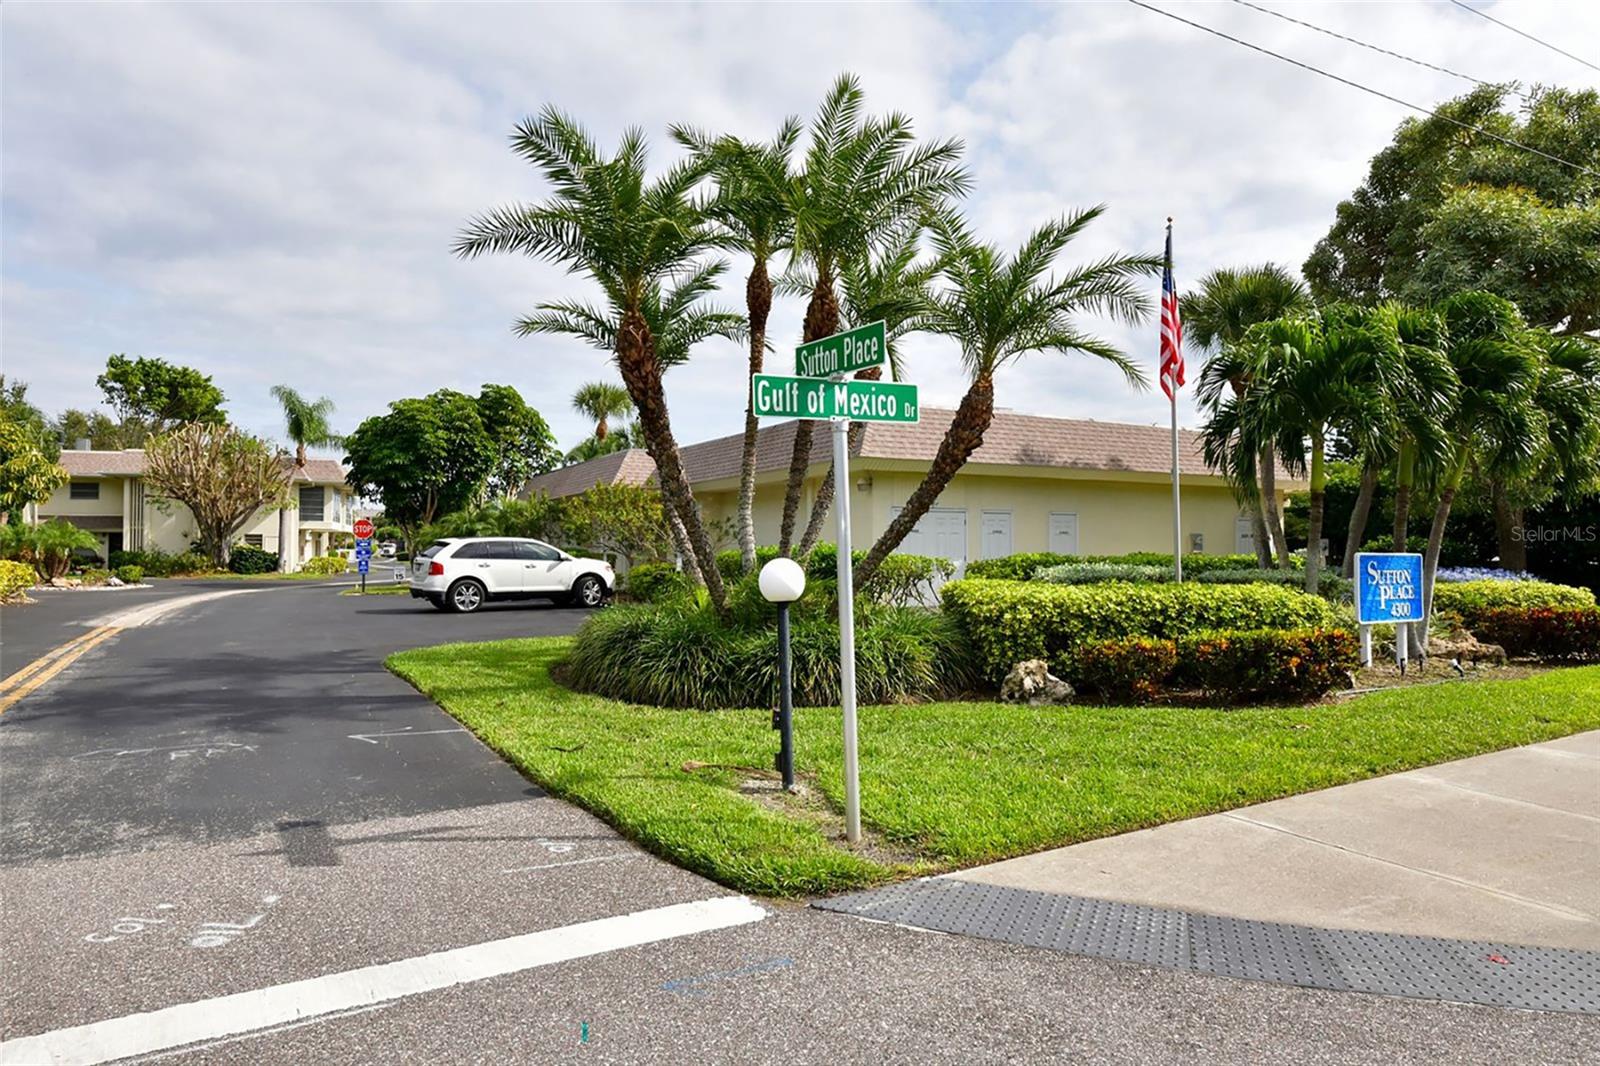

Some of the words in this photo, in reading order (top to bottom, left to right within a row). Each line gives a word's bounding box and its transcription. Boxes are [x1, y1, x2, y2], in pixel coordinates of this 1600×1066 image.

[801, 345, 838, 377] Sutton
[843, 336, 878, 367] Place
[757, 380, 799, 413] Gulf
[807, 384, 825, 414] of
[834, 385, 897, 417] Mexico
[904, 402, 916, 418] Dr
[354, 525, 373, 533] STOP
[1367, 560, 1412, 585] SUTTON
[1378, 585, 1415, 610] PLACE
